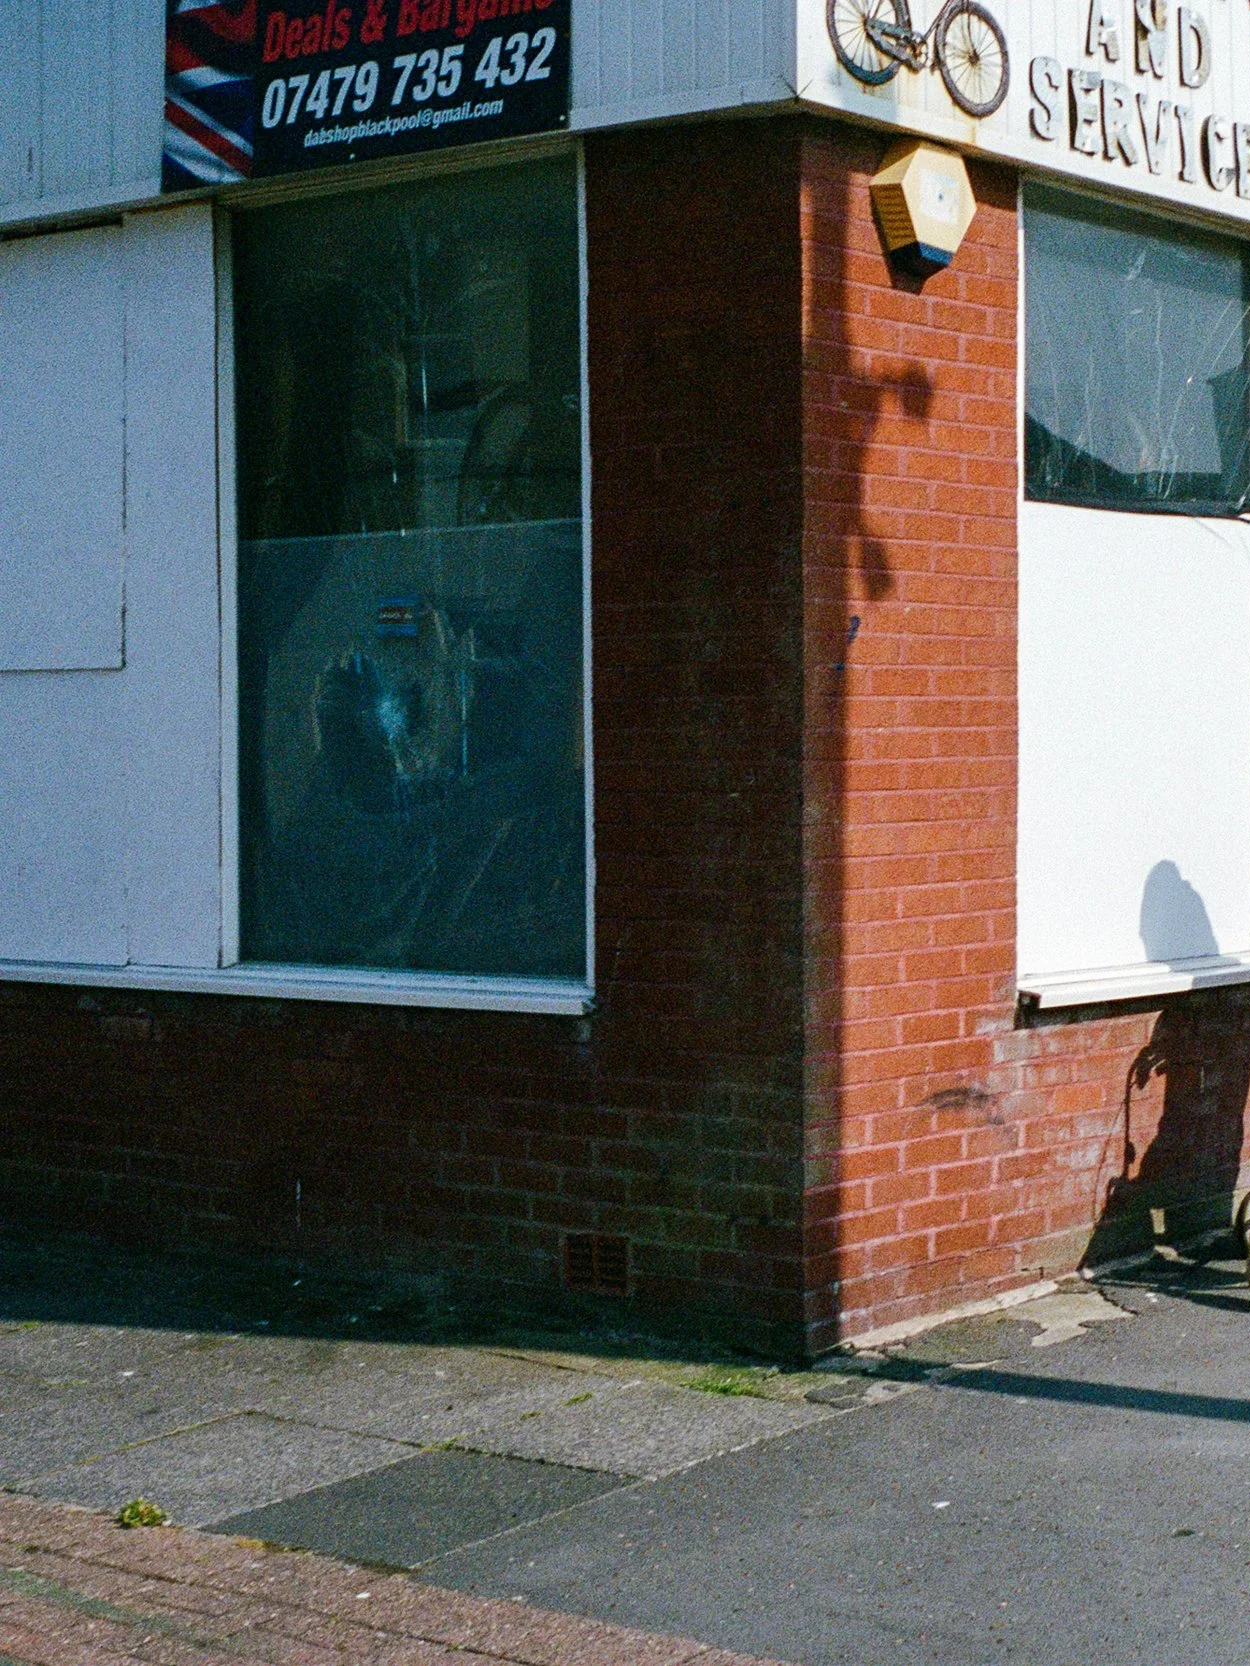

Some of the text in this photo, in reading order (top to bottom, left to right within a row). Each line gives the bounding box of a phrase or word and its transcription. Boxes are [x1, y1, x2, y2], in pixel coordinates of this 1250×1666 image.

[262, 0, 352, 63] Deals
[360, 0, 387, 44] &
[1086, 0, 1212, 89] AND
[261, 26, 557, 129] 07479 735 432
